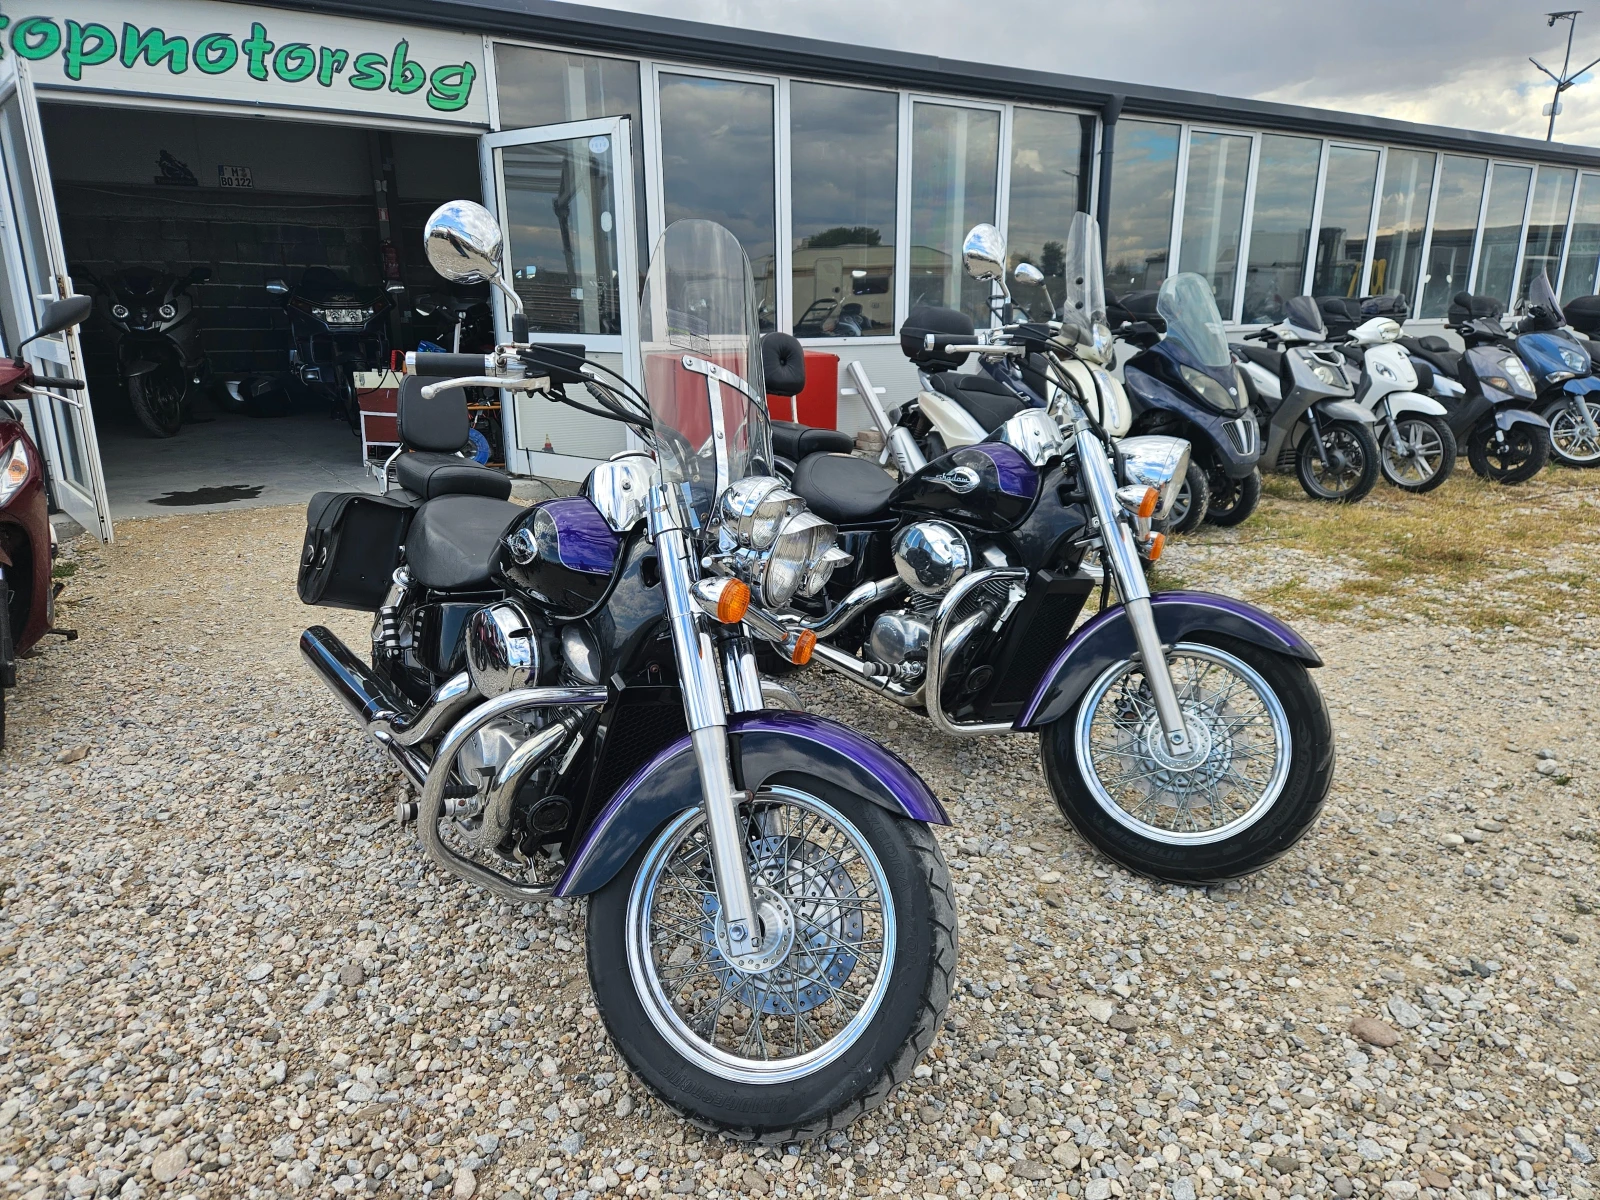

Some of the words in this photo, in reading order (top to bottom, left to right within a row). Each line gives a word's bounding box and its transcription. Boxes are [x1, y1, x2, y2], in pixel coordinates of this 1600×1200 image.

[0, 15, 478, 112] opmotorsbg
[235, 178, 251, 187] 122
[935, 472, 970, 483] Shadow
[1106, 825, 1188, 861] MICHELIN
